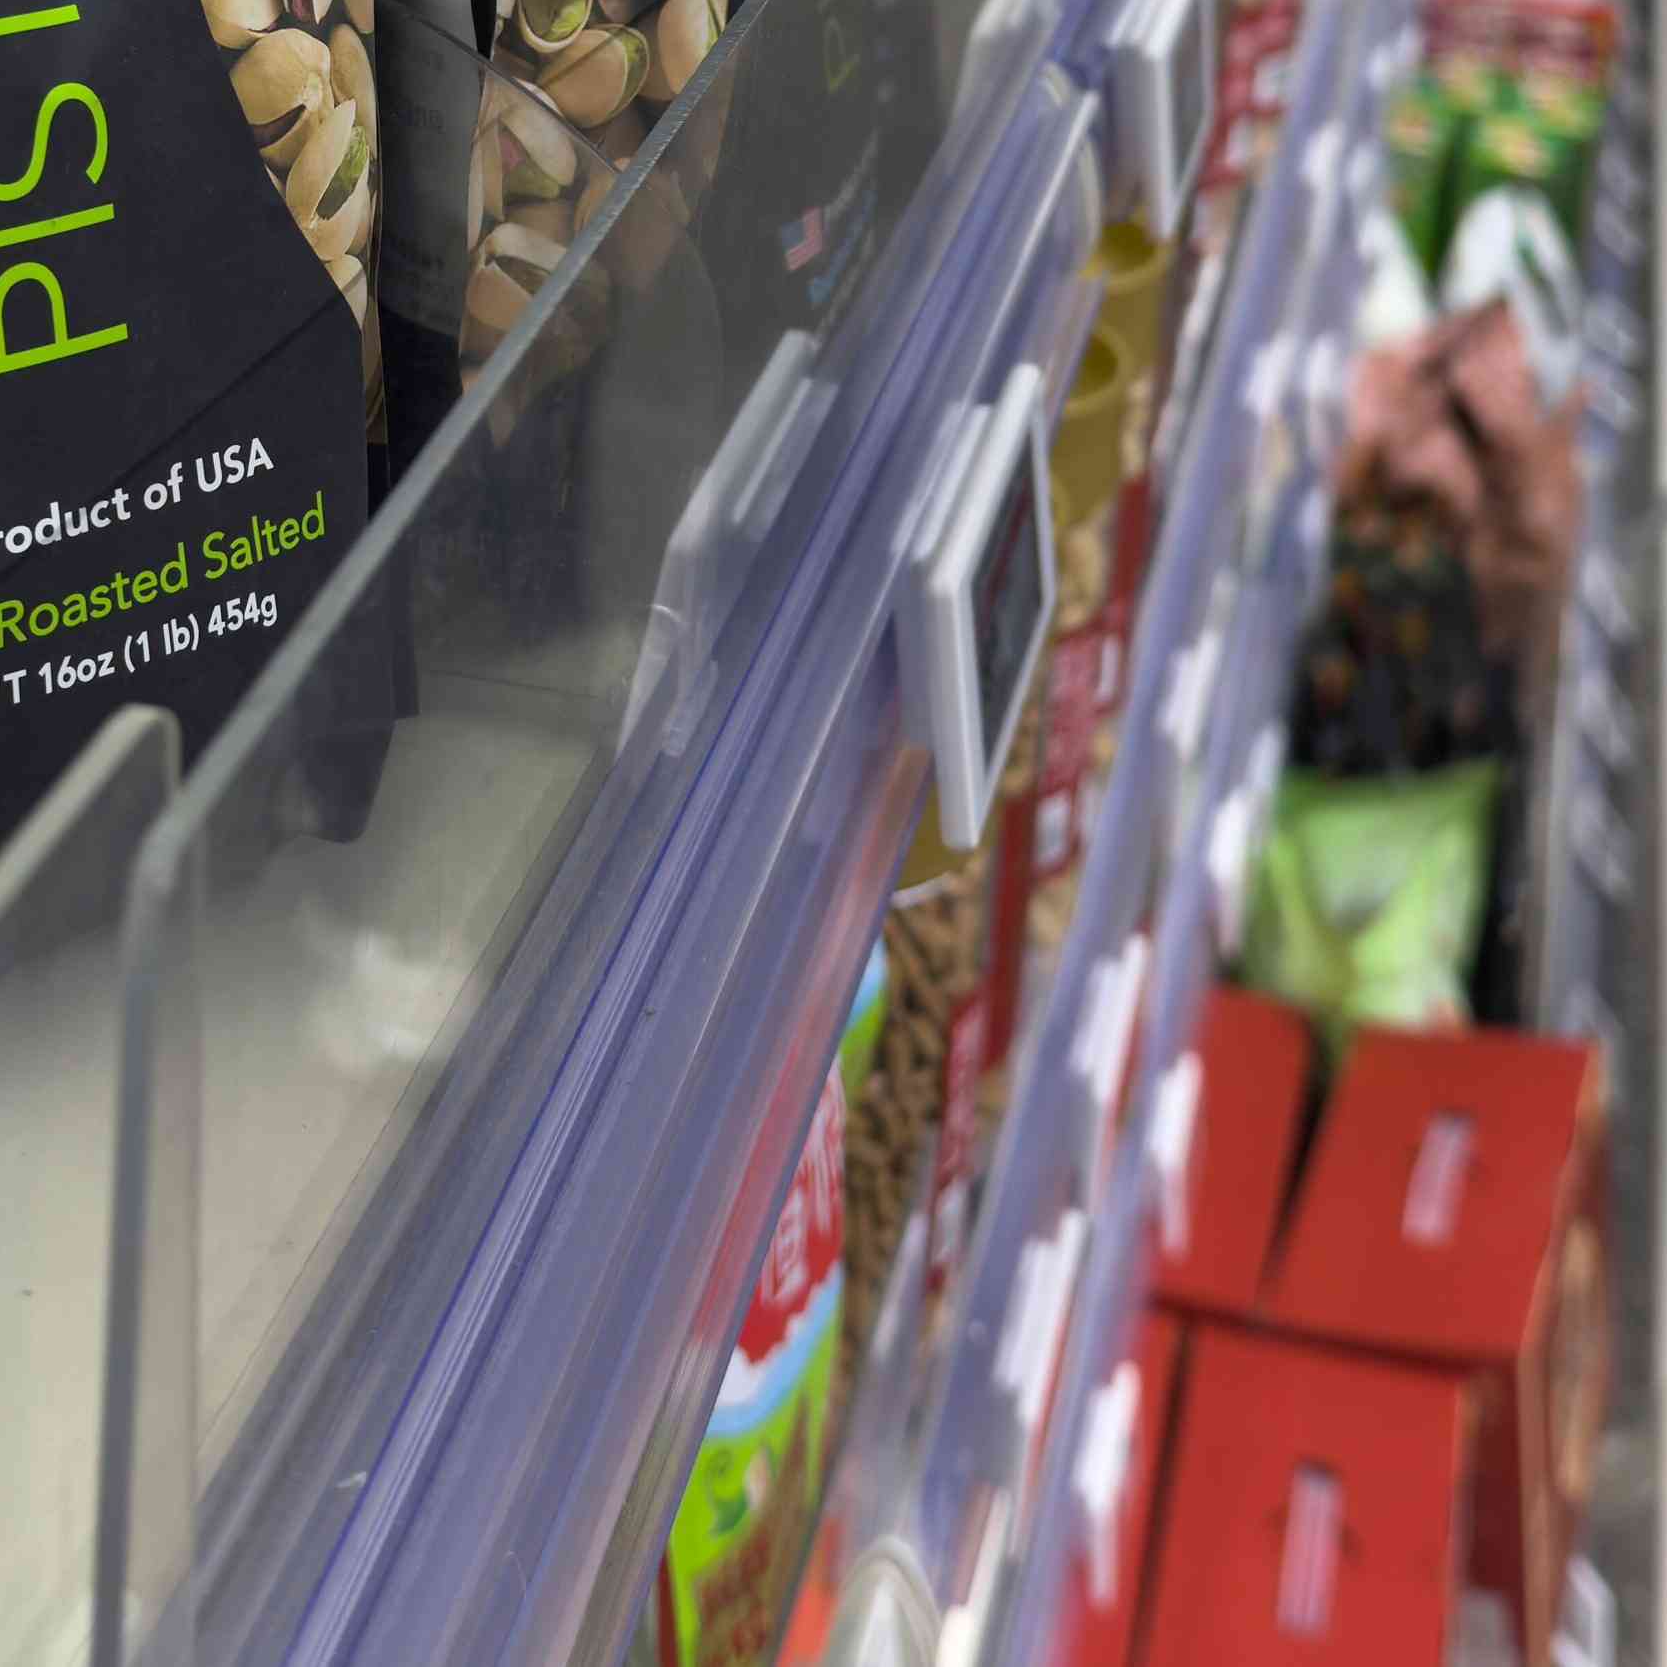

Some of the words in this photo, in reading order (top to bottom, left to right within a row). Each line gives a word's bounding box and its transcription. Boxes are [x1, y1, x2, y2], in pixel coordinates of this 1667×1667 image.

[142, 462, 184, 512] of
[195, 437, 275, 494] USA
[201, 489, 327, 580] Salted
[37, 649, 116, 695] 16oz
[123, 633, 151, 673] (1
[162, 614, 201, 657] lb)
[206, 592, 278, 638] 454g
